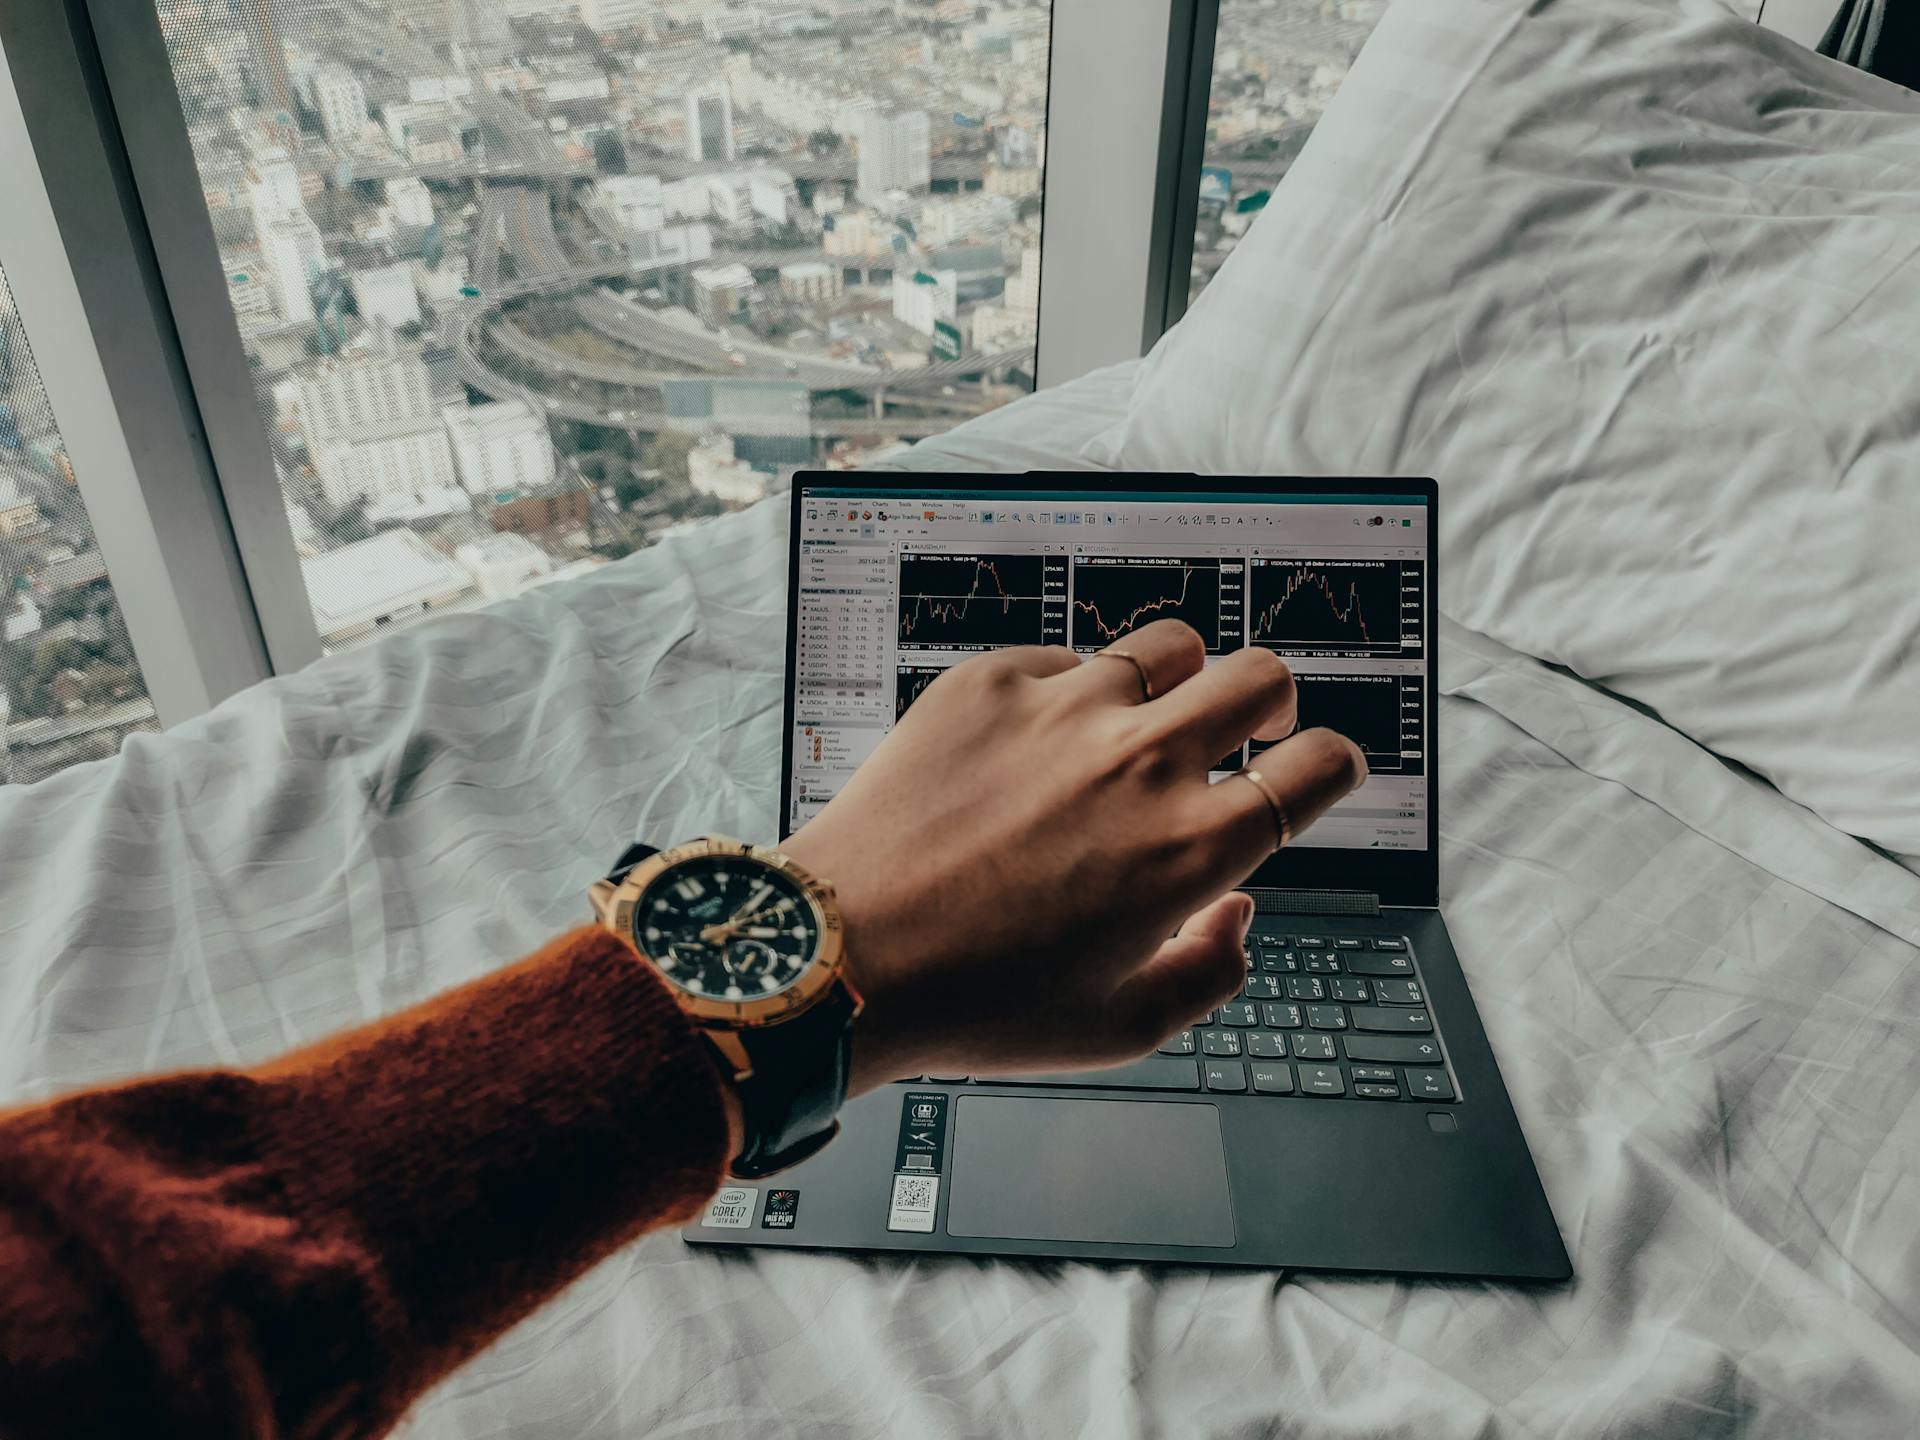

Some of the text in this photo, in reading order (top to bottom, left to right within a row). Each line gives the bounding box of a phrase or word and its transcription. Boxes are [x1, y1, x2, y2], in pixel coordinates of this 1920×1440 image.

[1248, 978, 1257, 986] P
[1223, 1004, 1232, 1013] L
[723, 1193, 742, 1201] intel
[712, 1206, 736, 1217] CORE
[764, 1214, 794, 1223] IRIS PLUS
